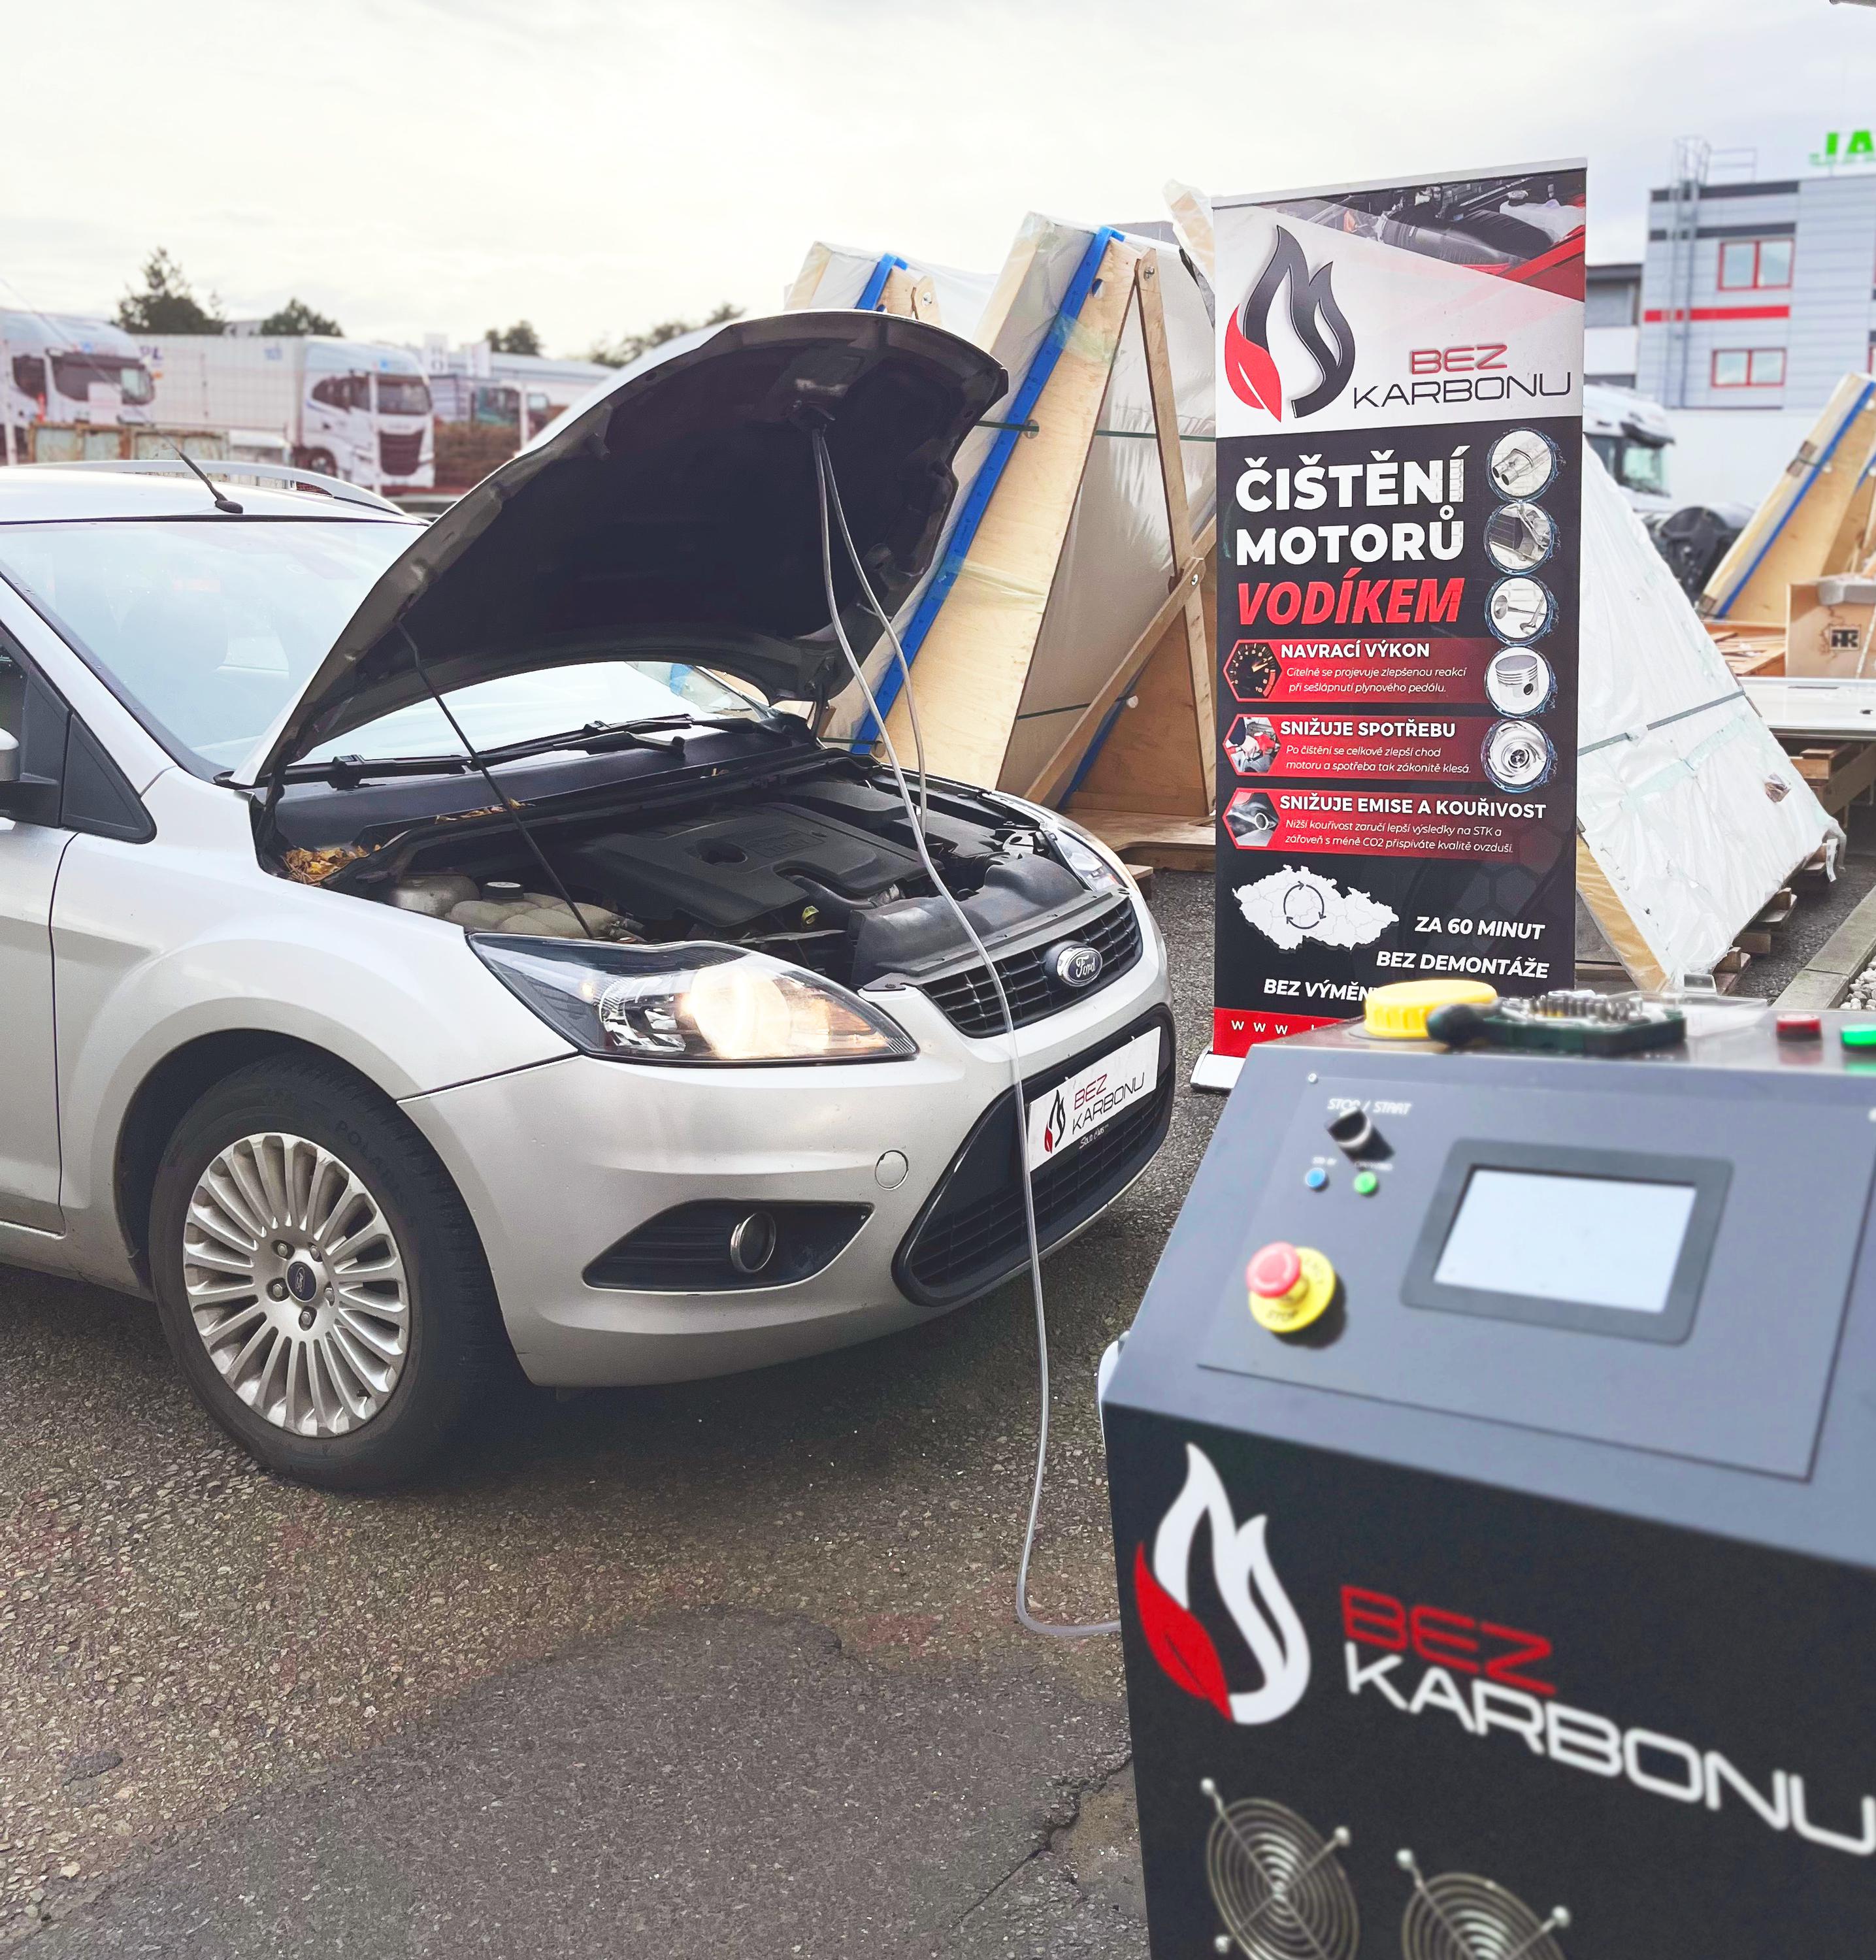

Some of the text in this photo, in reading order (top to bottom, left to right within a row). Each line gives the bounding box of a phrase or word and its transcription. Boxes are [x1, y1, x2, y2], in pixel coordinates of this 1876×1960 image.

[1410, 344, 1507, 374] BEZ
[1353, 372, 1572, 410] KARBONU
[1235, 445, 1470, 513] ČIŠTĚNÍ
[1236, 504, 1464, 566] MOTORŮ
[1238, 567, 1466, 625] VODÍKEM
[1281, 640, 1430, 659] NAVRACÍ VÝKON
[1334, 668, 1379, 679] projevuje
[1381, 667, 1432, 678] zlepšenou
[1435, 666, 1468, 677] reakcí
[1289, 682, 1446, 693] při sešlápnutí plynového pedálu.
[1280, 717, 1456, 738] SNIŽUJE SPOTŘEBU
[1287, 745, 1299, 754] Po
[1300, 745, 1332, 755] čištění
[1346, 746, 1383, 756] celkově
[1385, 746, 1413, 757] zlepší
[1415, 747, 1441, 757] chod
[1286, 762, 1322, 770] motoru
[1332, 762, 1375, 772] spotřeba
[1378, 762, 1394, 772] tak
[1396, 762, 1441, 773] zákonitě
[1279, 792, 1547, 819] SNIŽUJE EMISE A KOUŘIVOST
[1285, 819, 1502, 837] Nižší kouřivost zaručí lepší výsledky na STK a
[1332, 836, 1361, 847] méně
[1362, 838, 1384, 847] CO2
[1438, 840, 1472, 851] kvalitě
[1415, 916, 1546, 941] ZA 60 MINUT
[1075, 955, 1096, 979] Ford
[1376, 951, 1550, 979] BEZ DEMONTÁŽE
[1263, 979, 1375, 1002] BEZ VÝMĚN
[1072, 1071, 1145, 1135] KARBONU
[1074, 1073, 1108, 1111] BEZ
[1340, 1583, 1556, 1697] BEZ
[1343, 1641, 1876, 1857] KARBONU
